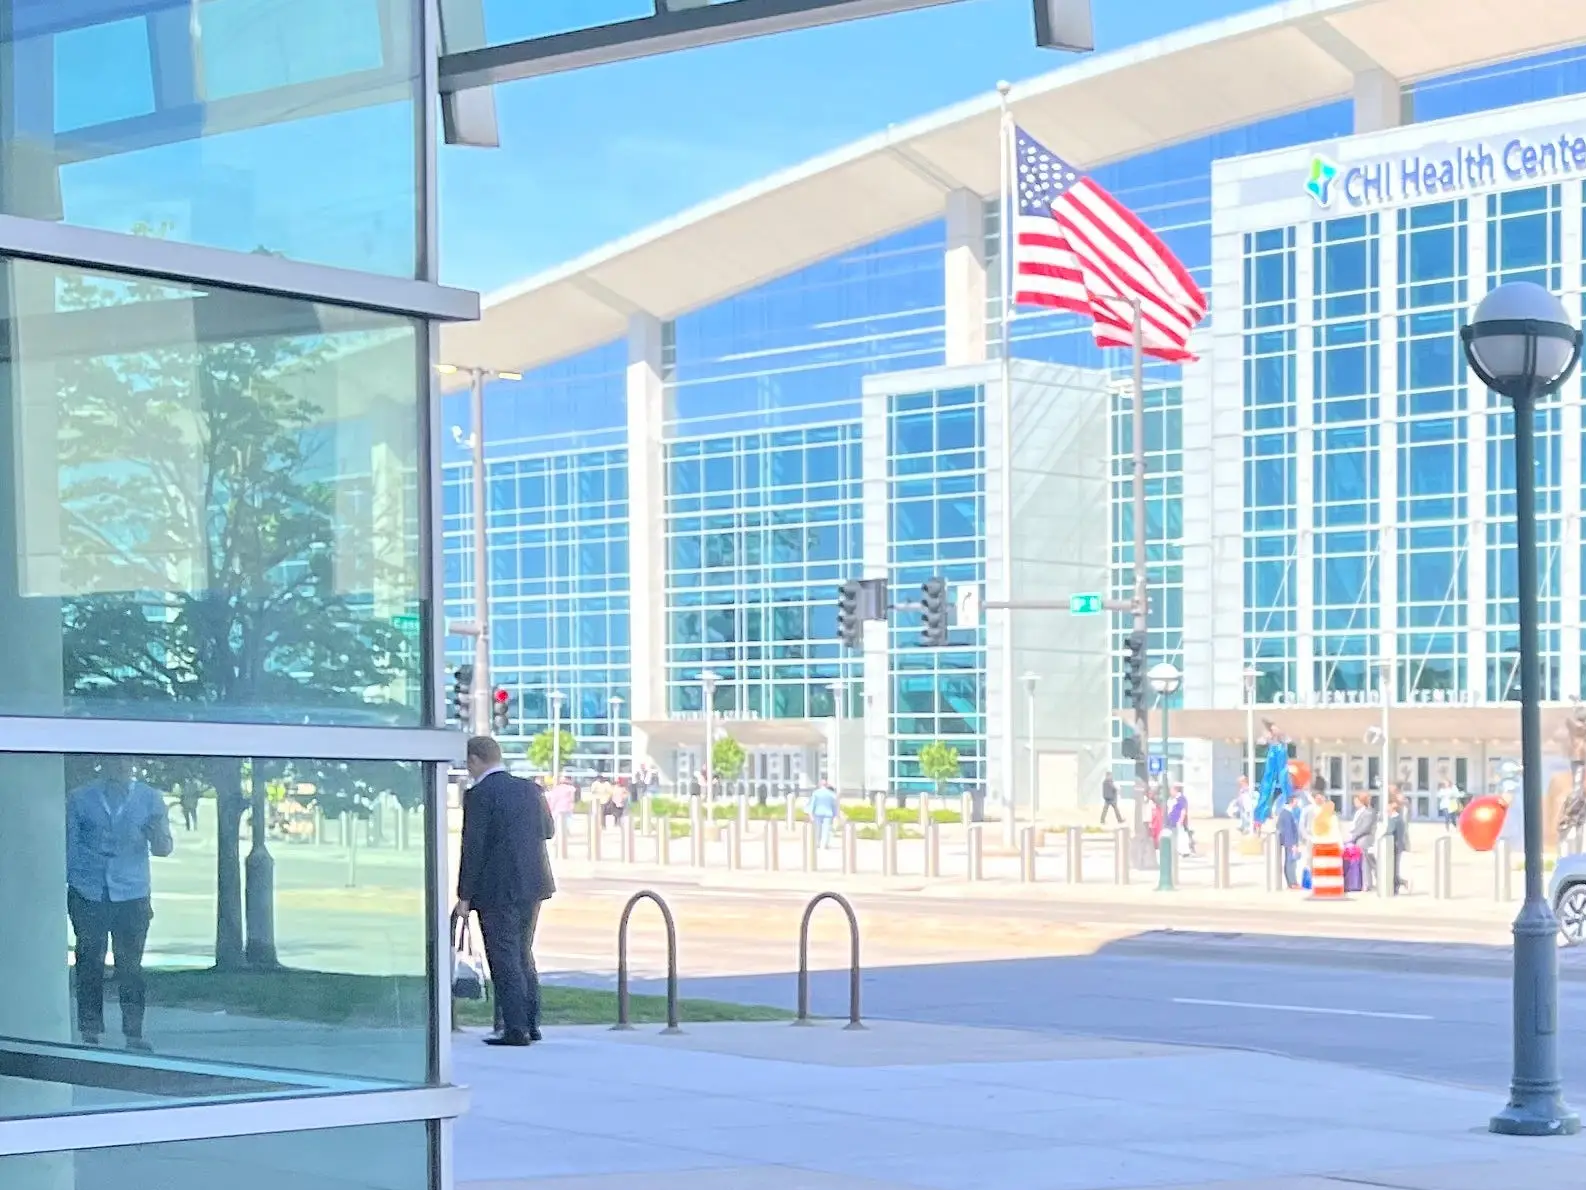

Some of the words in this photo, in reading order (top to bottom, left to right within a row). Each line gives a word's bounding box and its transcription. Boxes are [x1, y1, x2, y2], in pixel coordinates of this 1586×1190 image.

[1343, 159, 1391, 206] CHI
[1401, 144, 1496, 197] Health
[1273, 689, 1390, 706] COVENTIO
